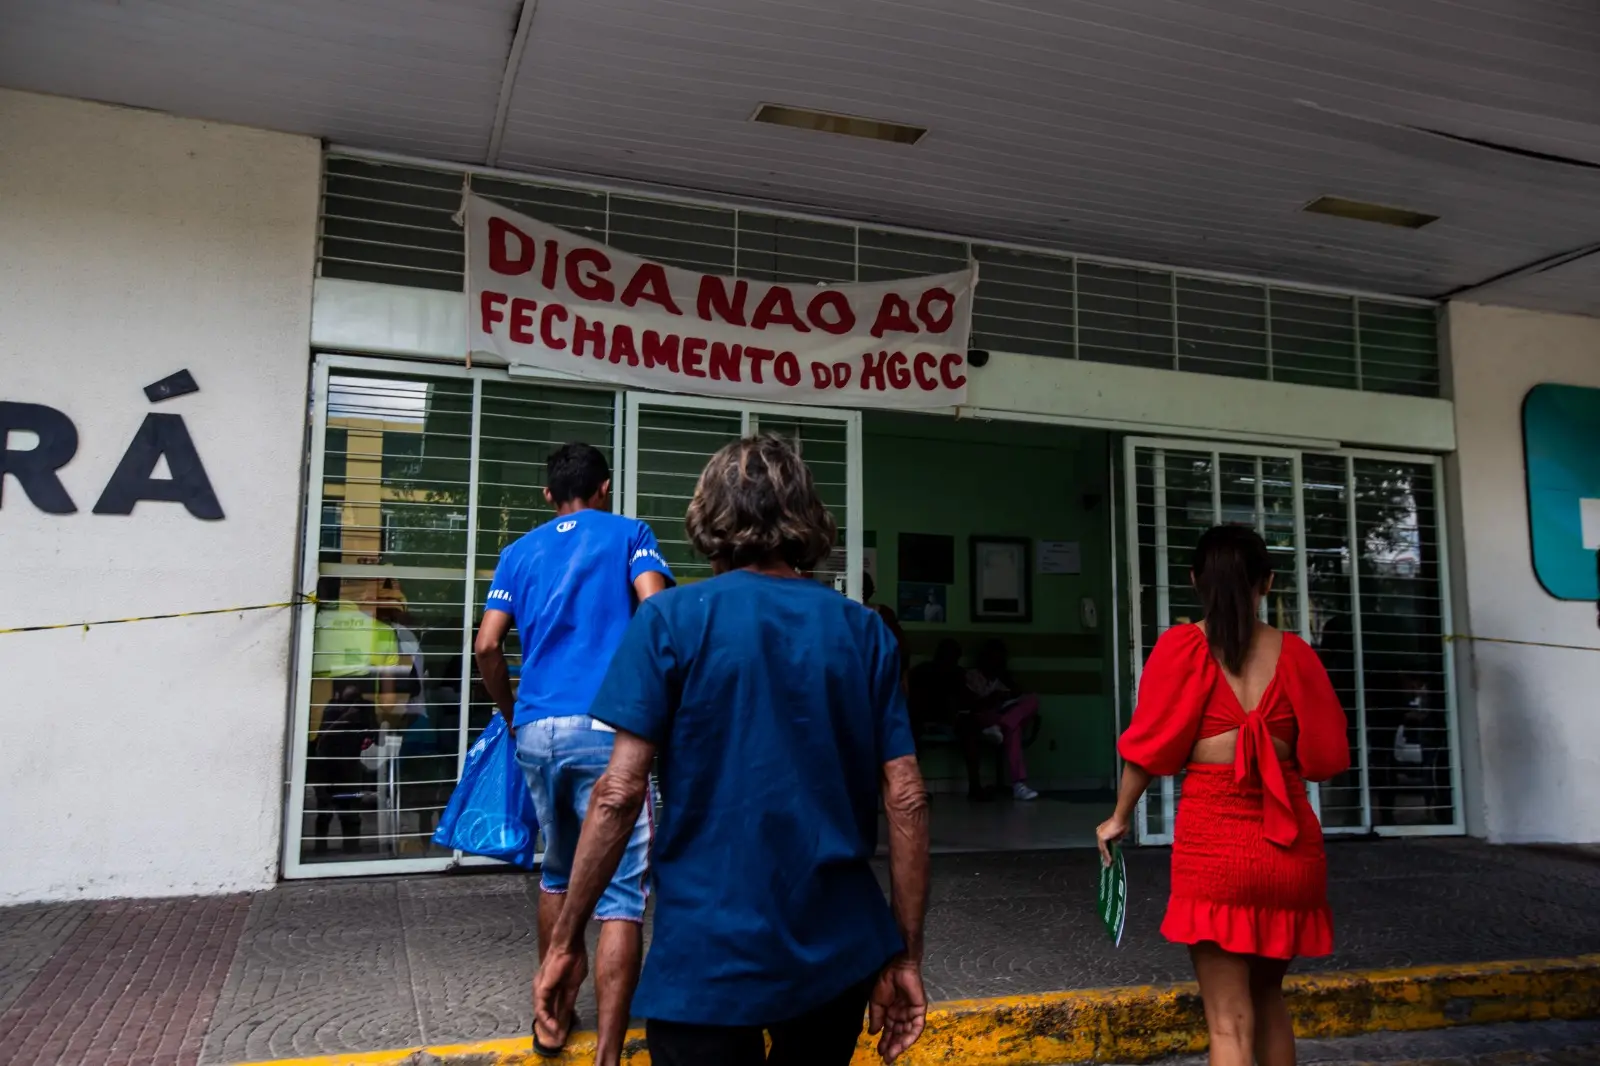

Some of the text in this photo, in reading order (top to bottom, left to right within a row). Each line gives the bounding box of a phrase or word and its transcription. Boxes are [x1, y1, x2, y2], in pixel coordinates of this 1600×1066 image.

[488, 216, 683, 316] DIGA
[870, 287, 955, 339] AO
[480, 290, 801, 387] FECHAMENTO
[860, 351, 967, 391] HGCC
